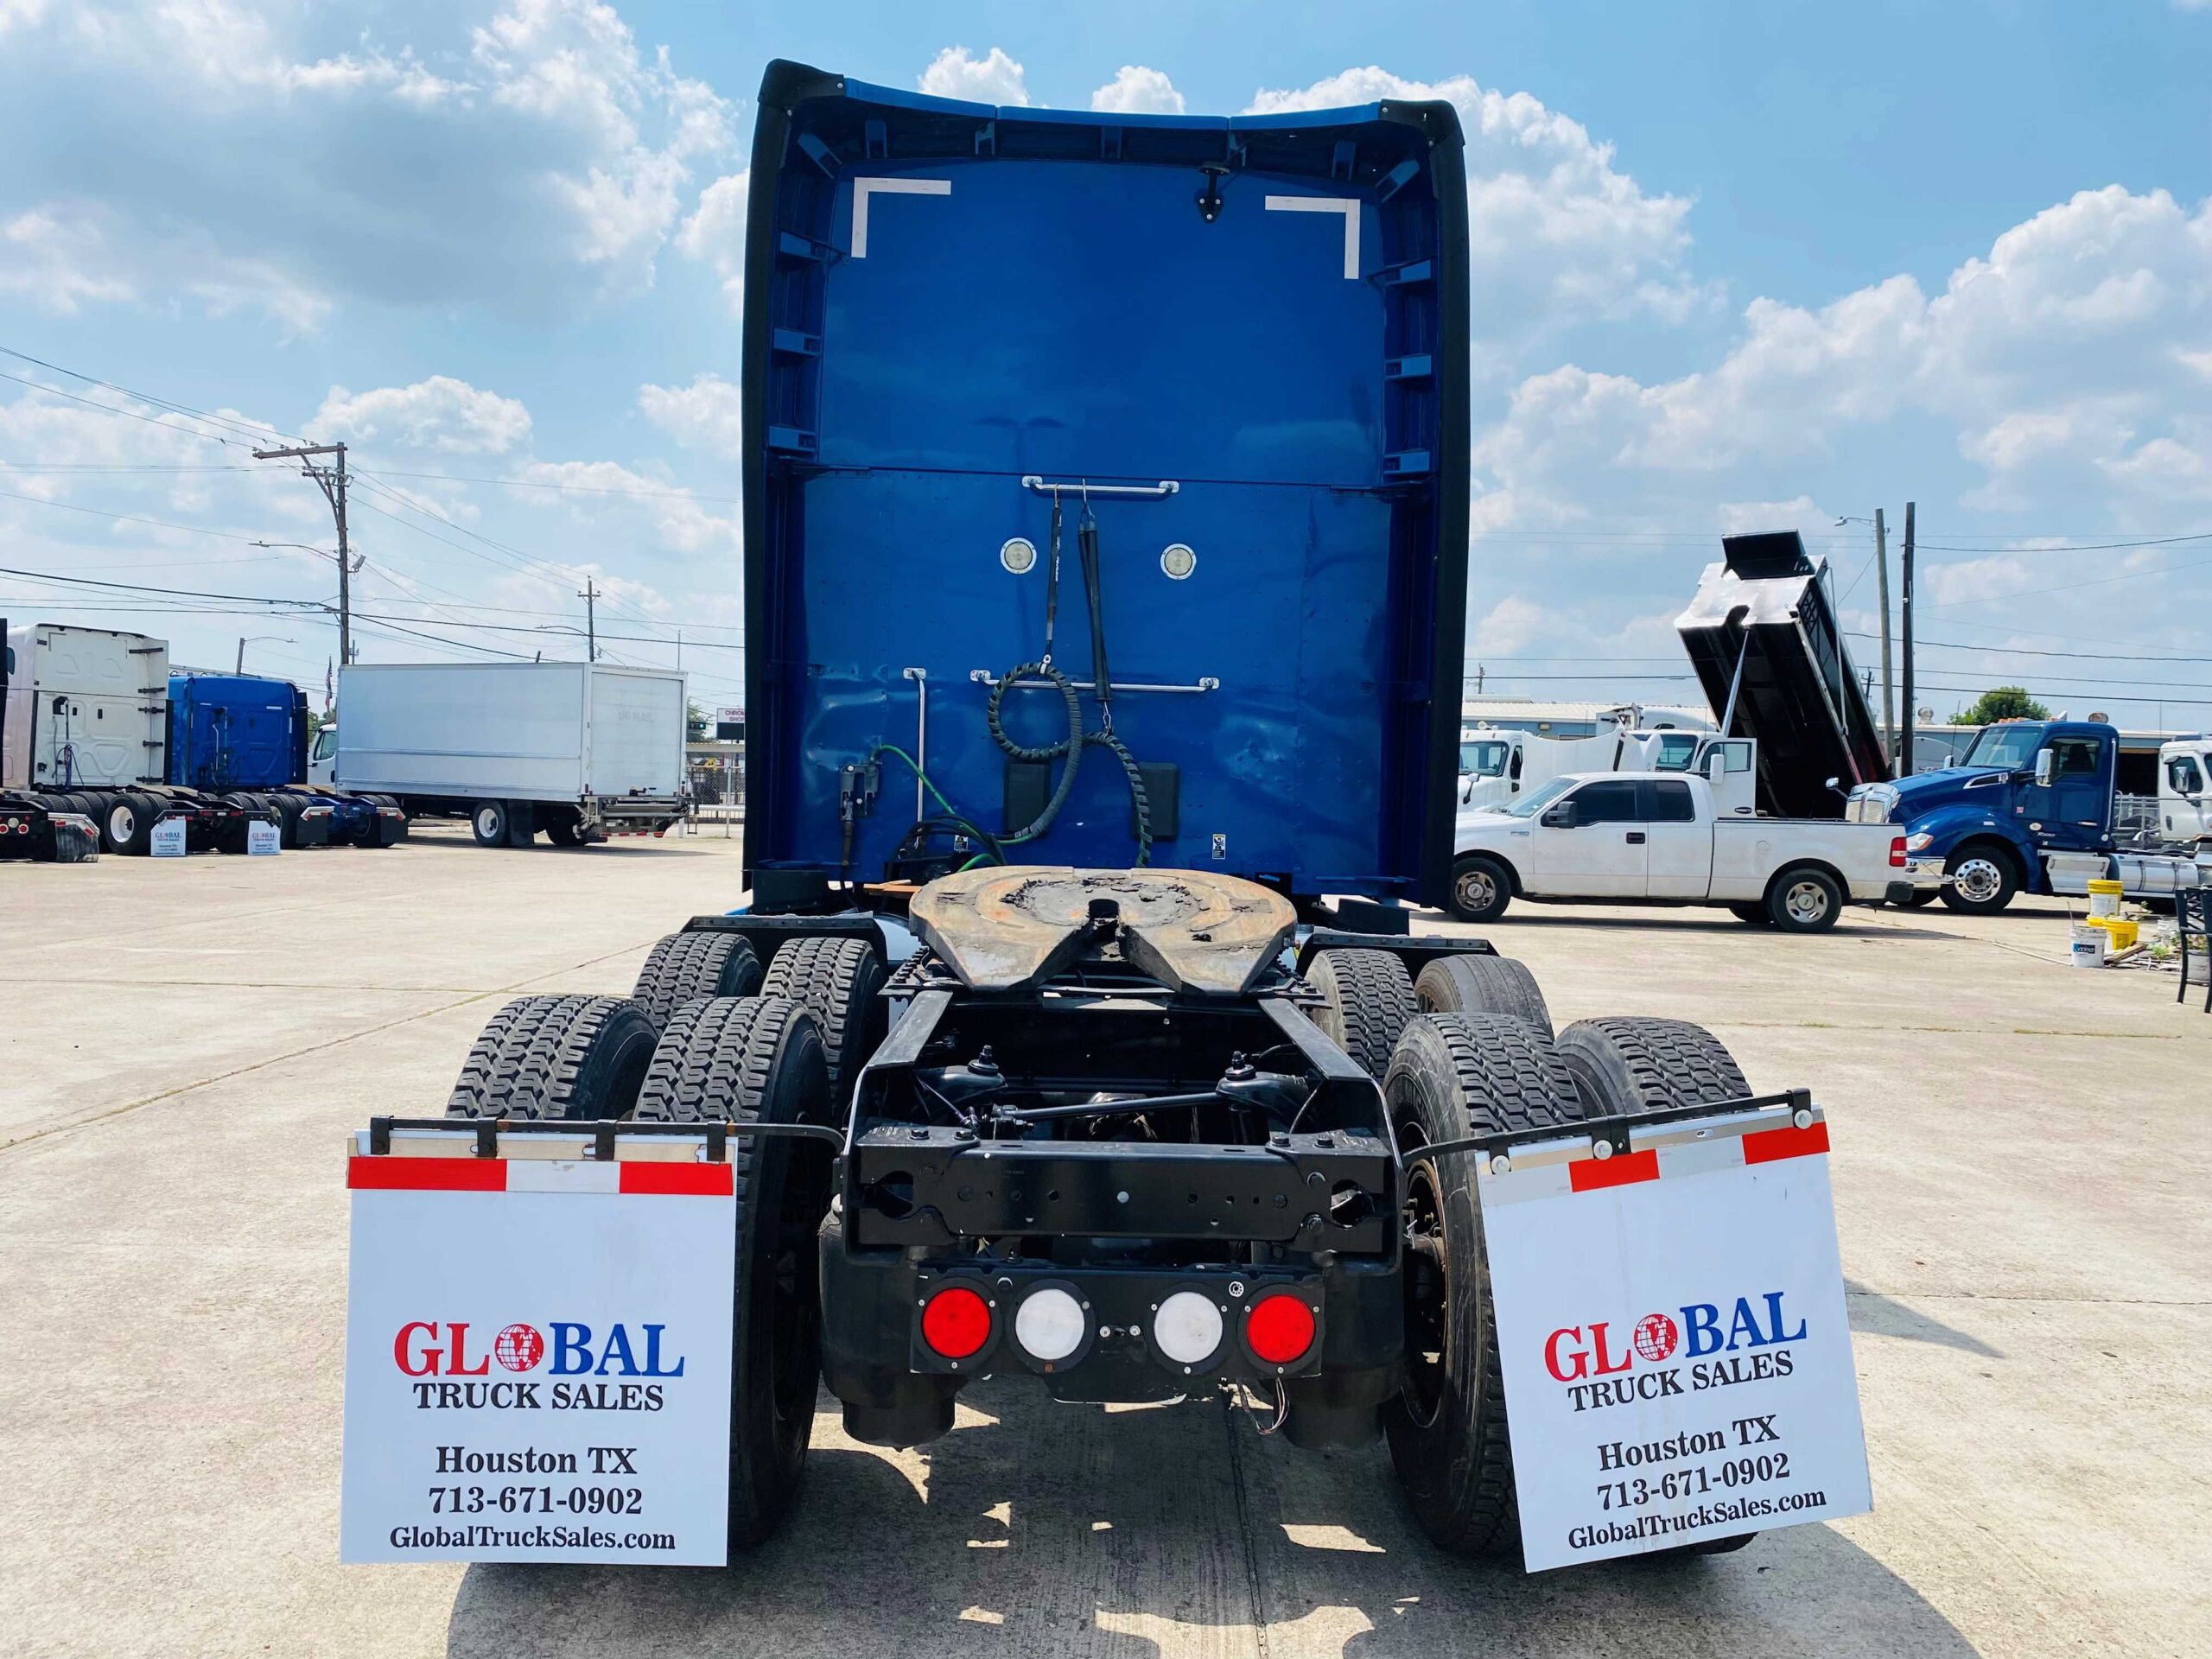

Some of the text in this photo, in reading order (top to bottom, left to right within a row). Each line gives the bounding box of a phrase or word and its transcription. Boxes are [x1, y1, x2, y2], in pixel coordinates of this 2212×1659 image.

[394, 1321, 685, 1377] GLOBAL
[1545, 1292, 1807, 1382] GLOBAL
[413, 1383, 663, 1411] TRUCK SALES
[1568, 1350, 1793, 1412] TRUCK SALES
[435, 1446, 637, 1474] Houston TX
[1598, 1414, 1780, 1471] Houston TX
[429, 1487, 641, 1514] 713-671-0902
[1598, 1453, 1789, 1510] 713-671-0902
[391, 1526, 675, 1549] GlobalTruckSales.com
[1569, 1491, 1827, 1548] GlobalTruckSales.com
